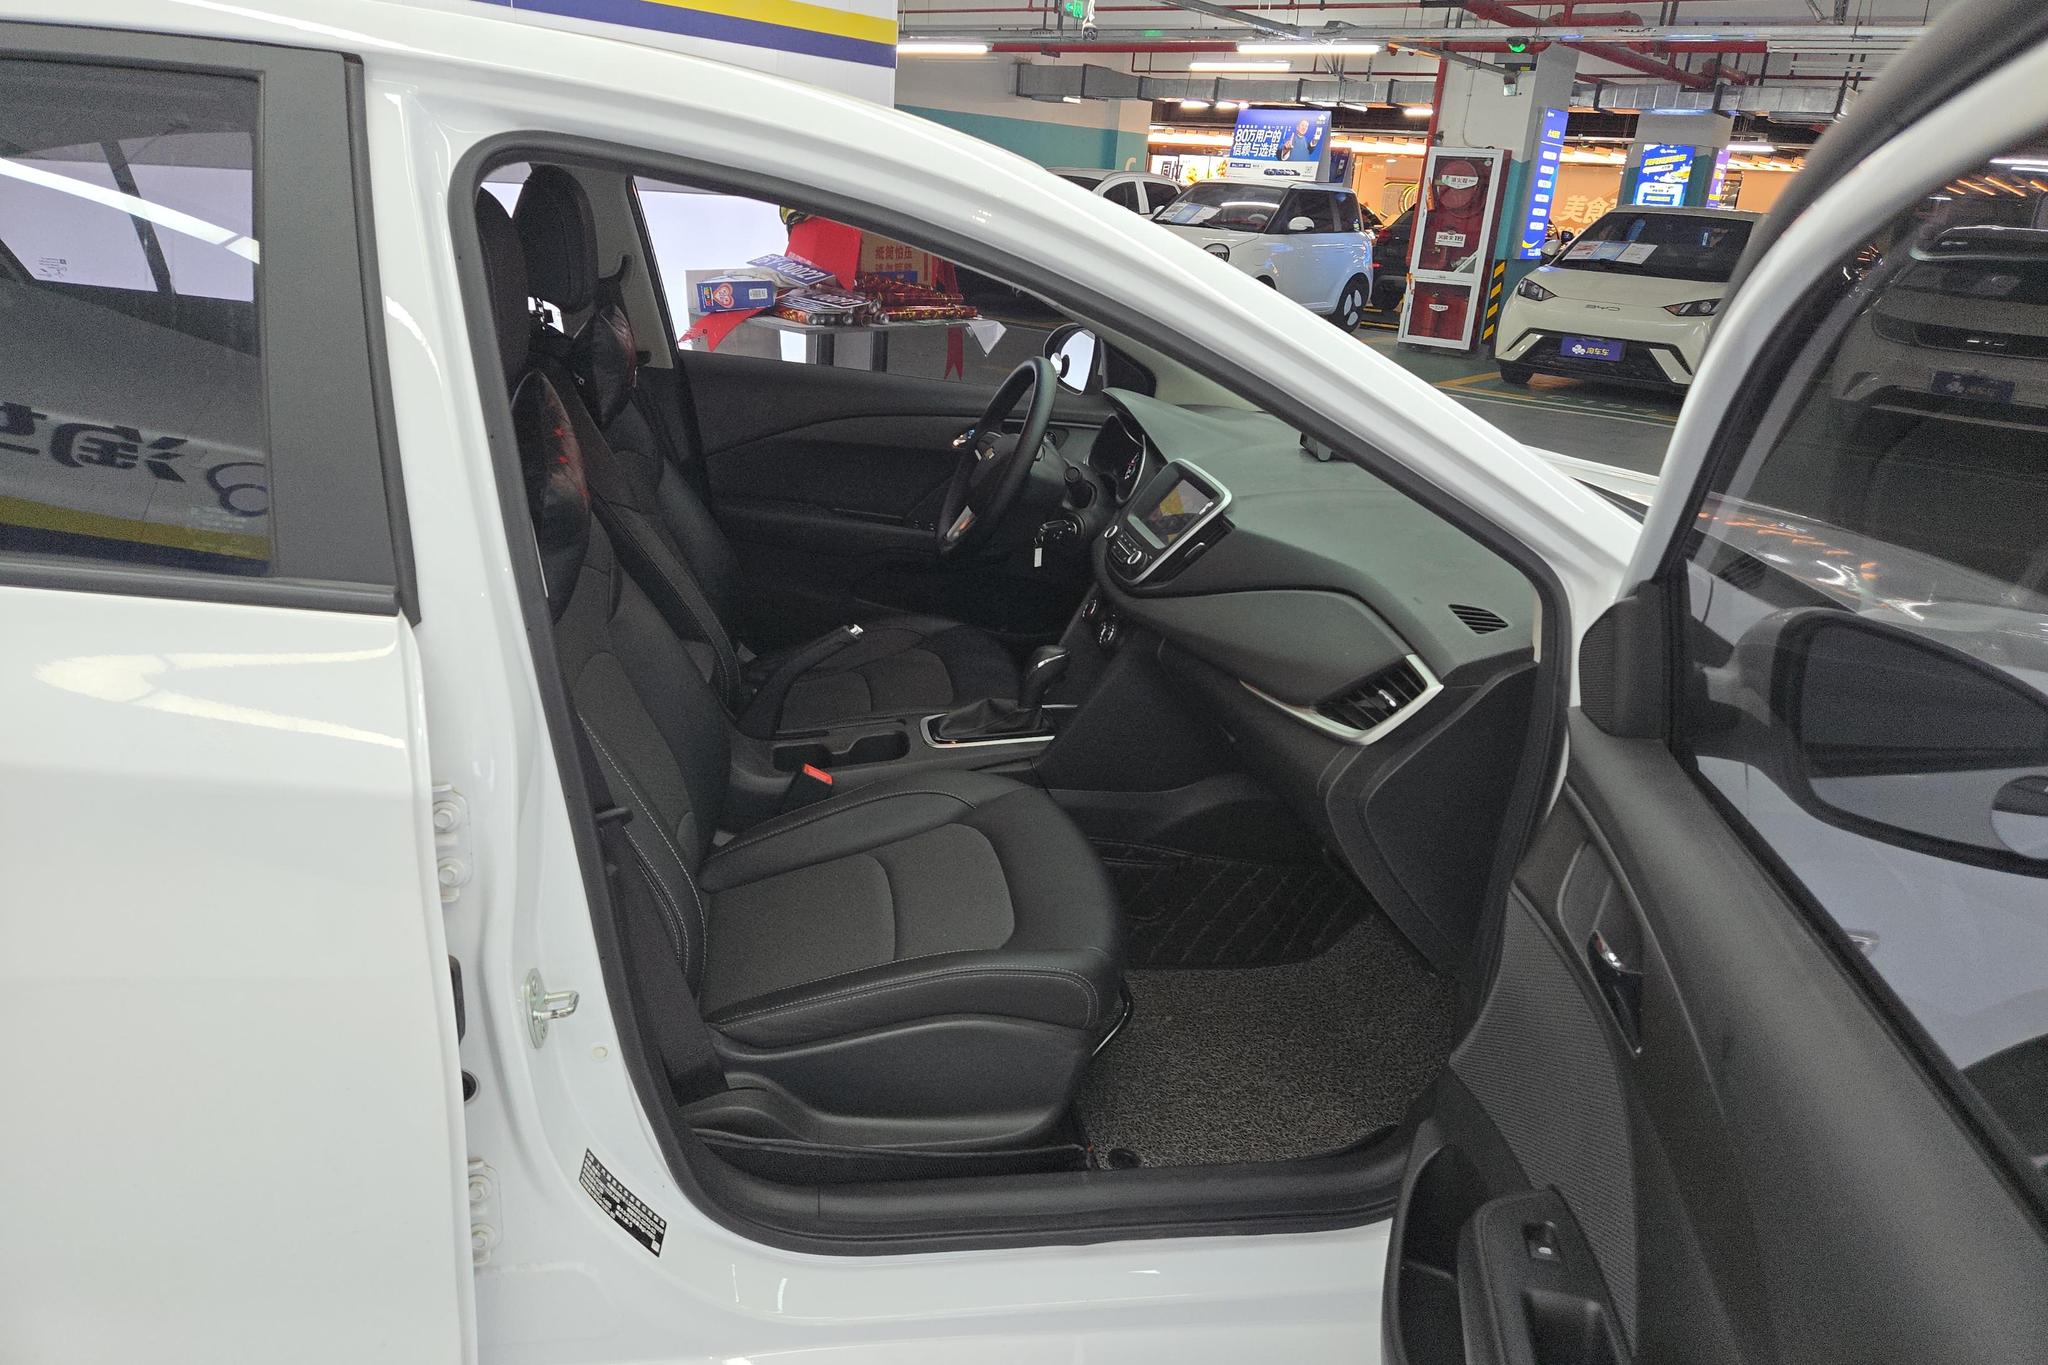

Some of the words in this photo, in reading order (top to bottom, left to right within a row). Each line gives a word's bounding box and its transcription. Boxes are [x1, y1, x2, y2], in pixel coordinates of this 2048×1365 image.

[1235, 128, 1281, 143] 80万用户的
[1232, 141, 1279, 158] 信赖与选择
